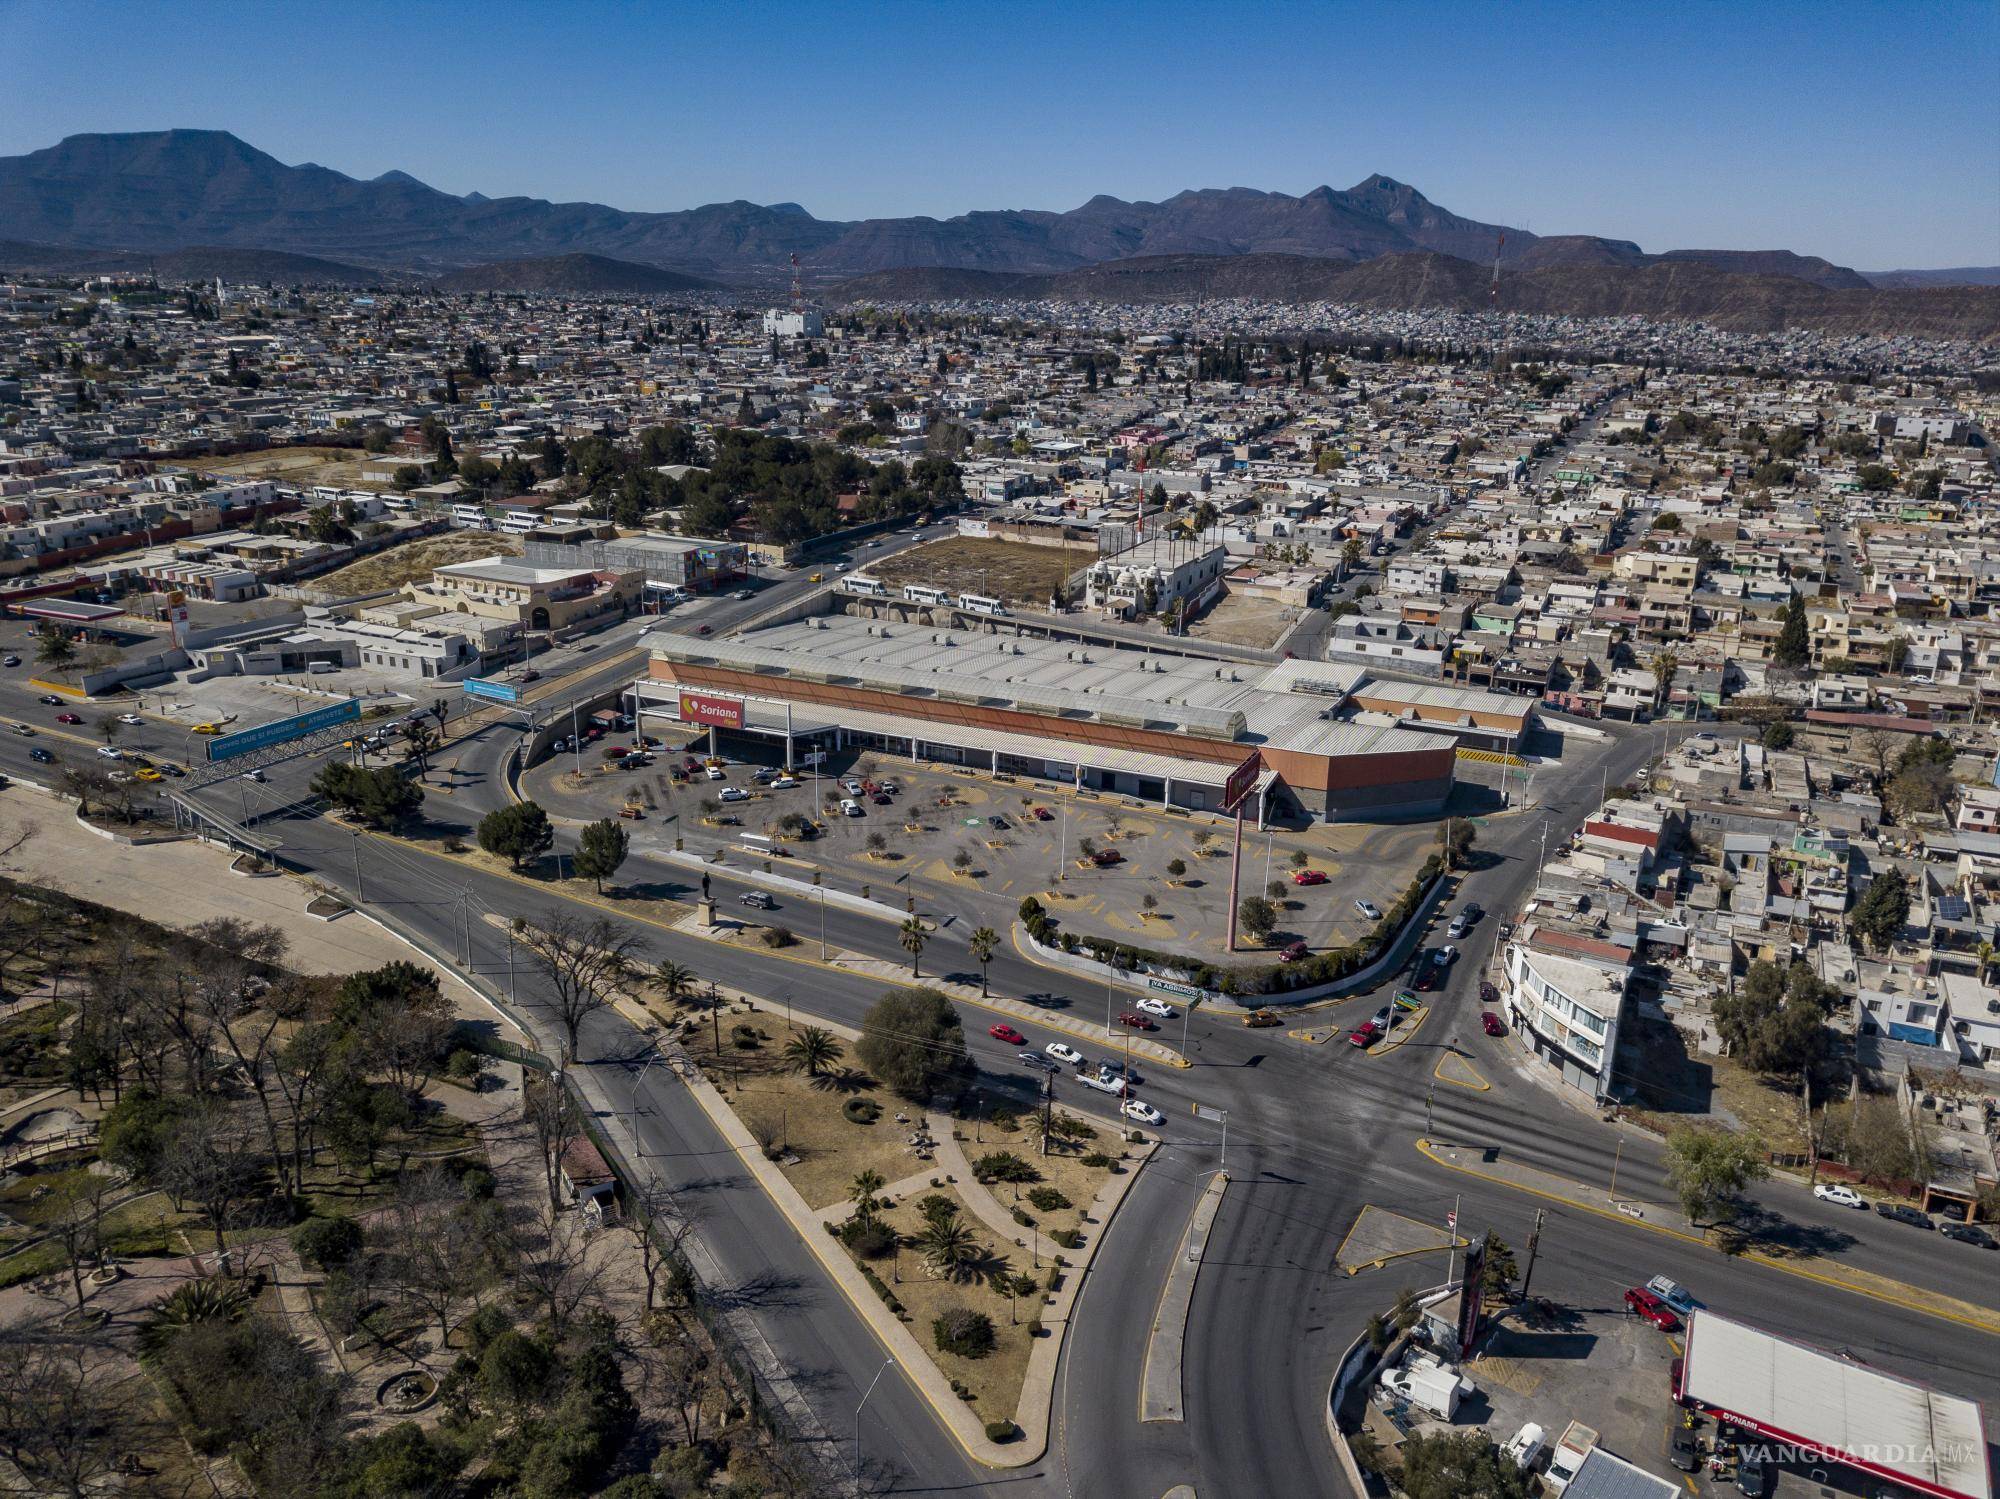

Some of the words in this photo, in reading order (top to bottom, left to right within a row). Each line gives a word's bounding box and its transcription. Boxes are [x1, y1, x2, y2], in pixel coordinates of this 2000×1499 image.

[701, 704, 738, 719] Soriana
[241, 735, 257, 744] QUE
[1575, 1041, 1600, 1060] DENTAL
